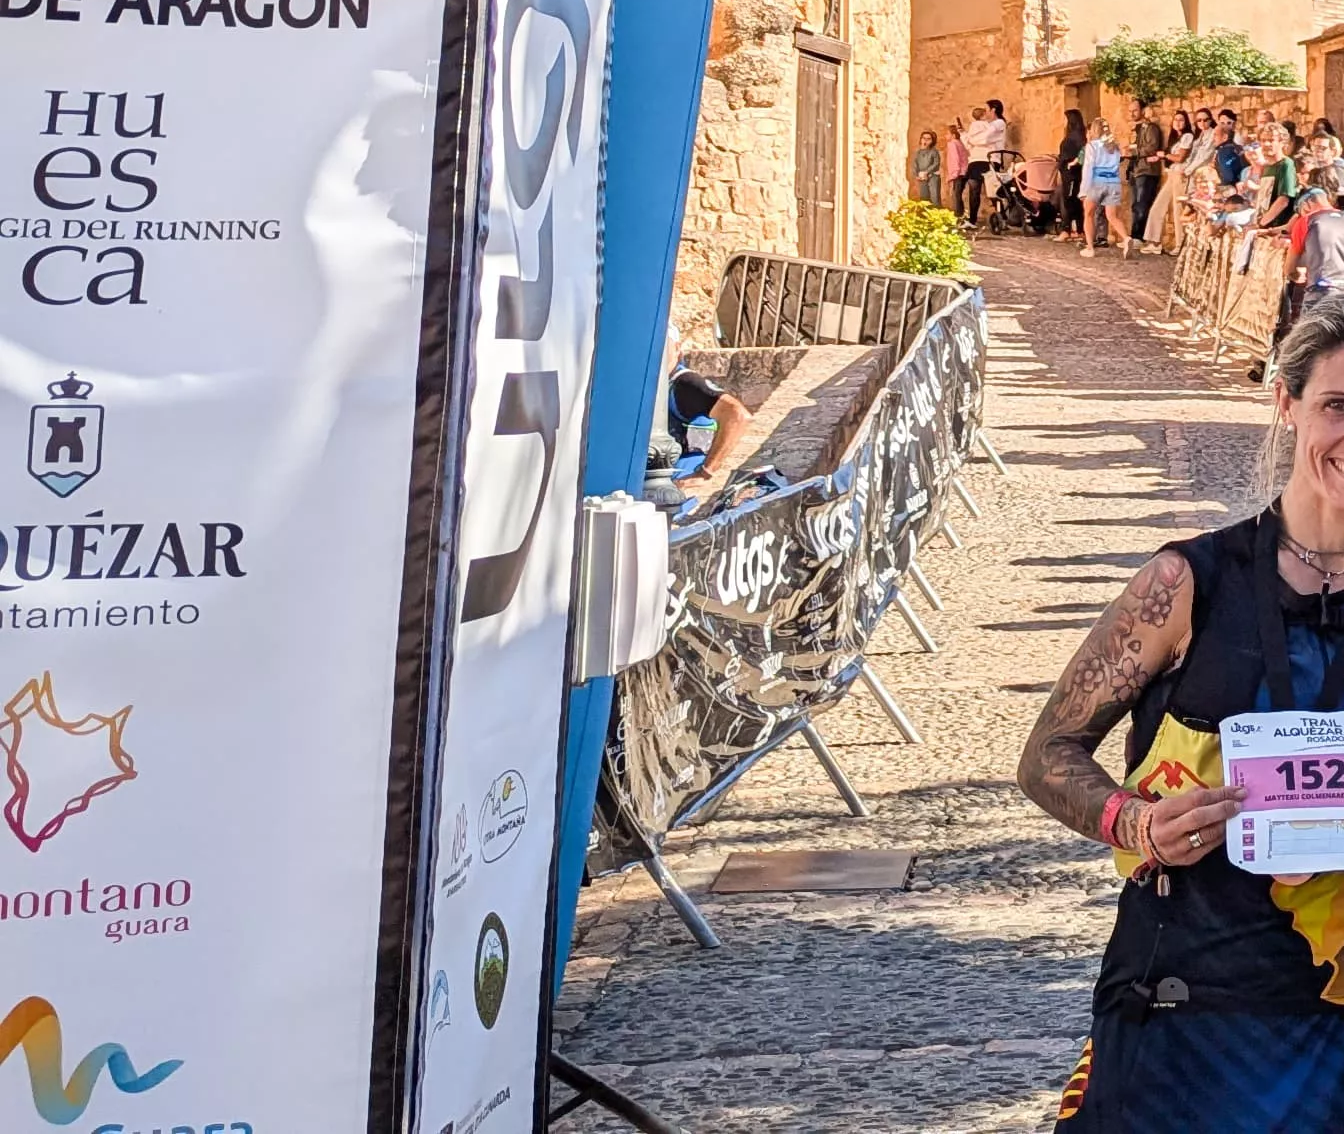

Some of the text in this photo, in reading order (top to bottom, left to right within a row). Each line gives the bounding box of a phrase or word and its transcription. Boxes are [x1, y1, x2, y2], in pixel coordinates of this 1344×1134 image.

[32, 146, 160, 213] es
[21, 245, 149, 306] ca
[0, 509, 248, 593] UÉZAR
[716, 528, 776, 614] utgs
[0, 599, 201, 629] tamiento
[1300, 718, 1342, 728] TRAIL
[0, 878, 192, 920] ontano
[104, 916, 190, 944] guara
